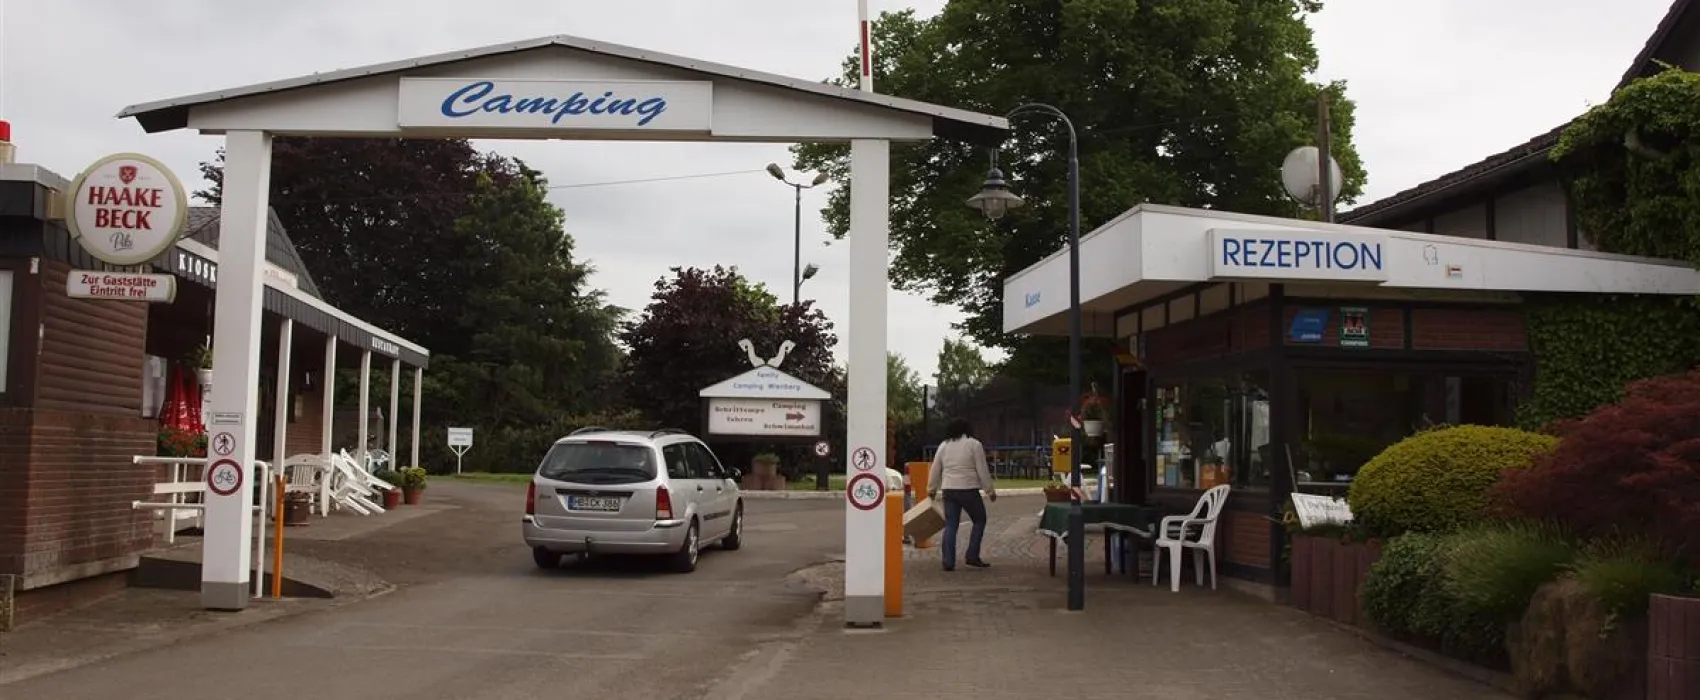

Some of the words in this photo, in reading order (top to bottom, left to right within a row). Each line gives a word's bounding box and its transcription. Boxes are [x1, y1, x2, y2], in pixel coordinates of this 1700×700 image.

[441, 81, 667, 126] Camping
[88, 186, 163, 208] HAAKE
[95, 208, 152, 230] BECK
[1223, 238, 1382, 270] REZEPTION
[179, 253, 216, 283] KIOSK
[81, 275, 99, 285] Zur
[103, 275, 157, 287] Gaststätte
[90, 286, 126, 297] Eintritt
[129, 286, 147, 297] frei
[733, 382, 764, 391] Camping
[772, 402, 806, 410] Camping
